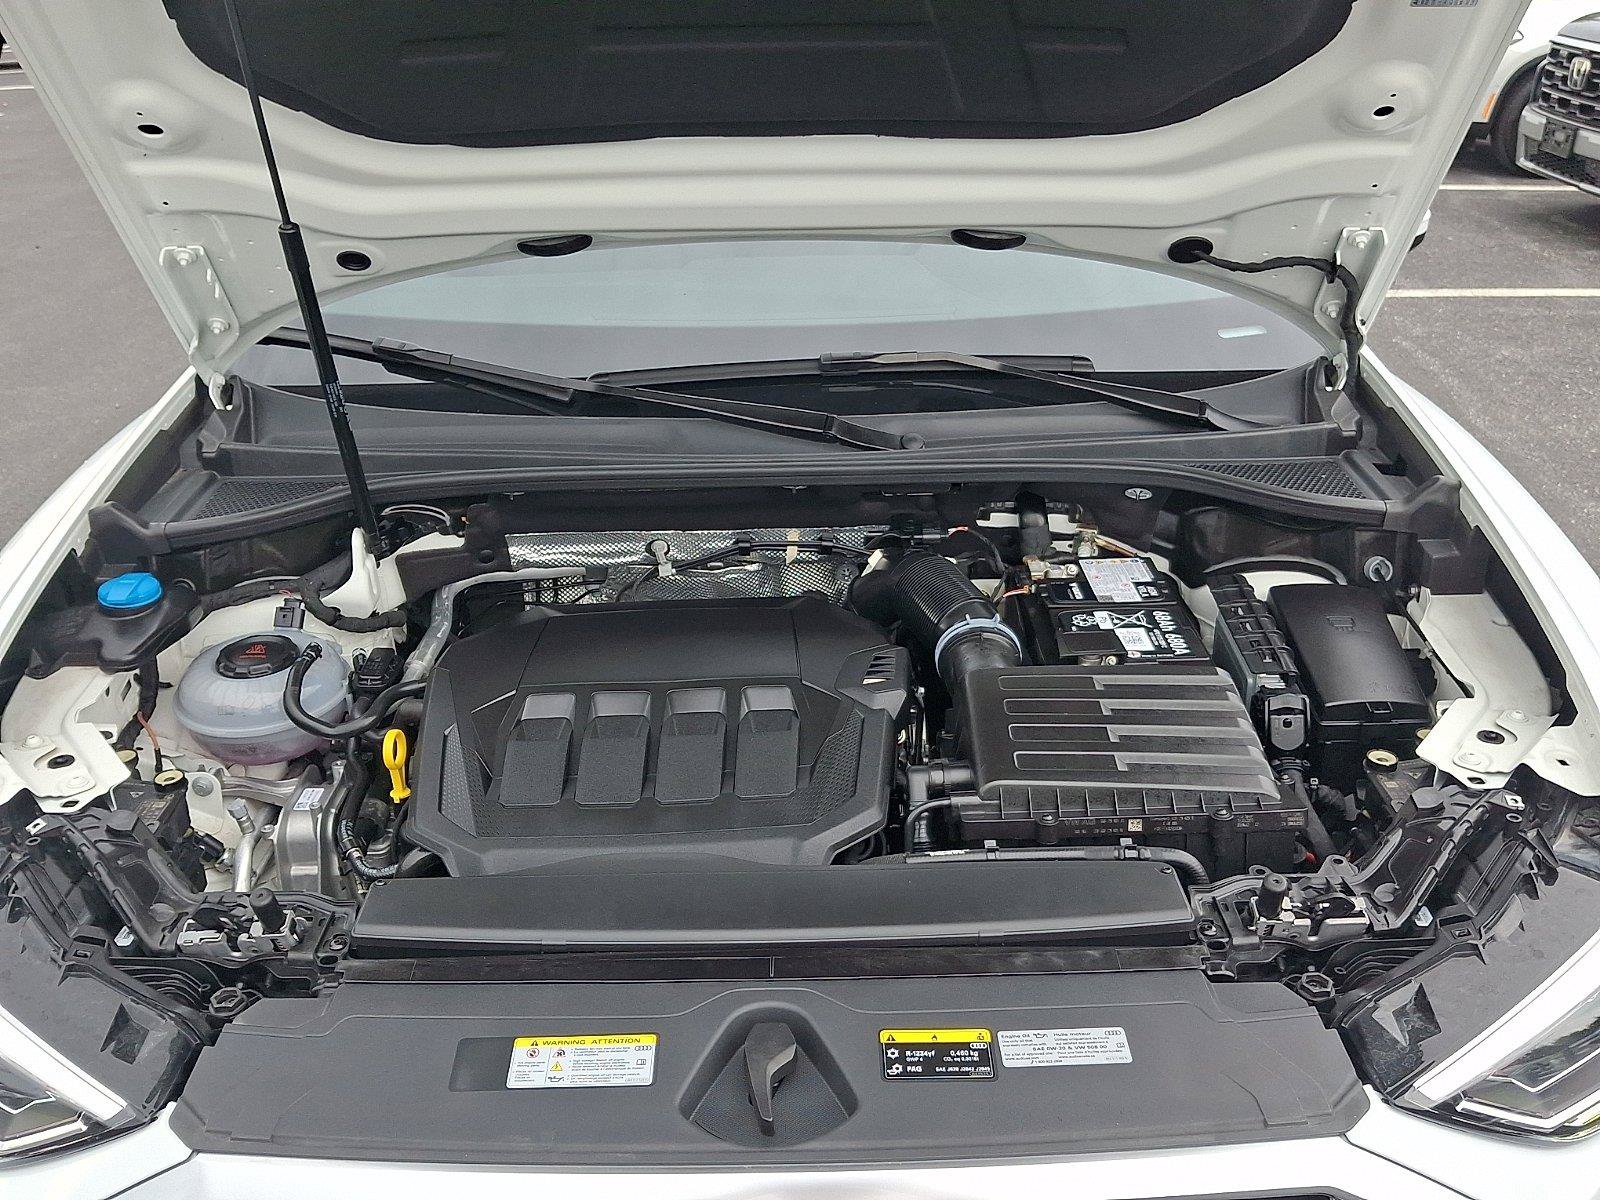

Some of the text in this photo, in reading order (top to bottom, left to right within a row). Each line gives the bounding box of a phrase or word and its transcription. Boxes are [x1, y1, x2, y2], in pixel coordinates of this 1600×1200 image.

[1152, 610, 1176, 632] 68Ah
[1164, 633, 1191, 655] 680A
[905, 1050, 935, 1058] R-1234yf
